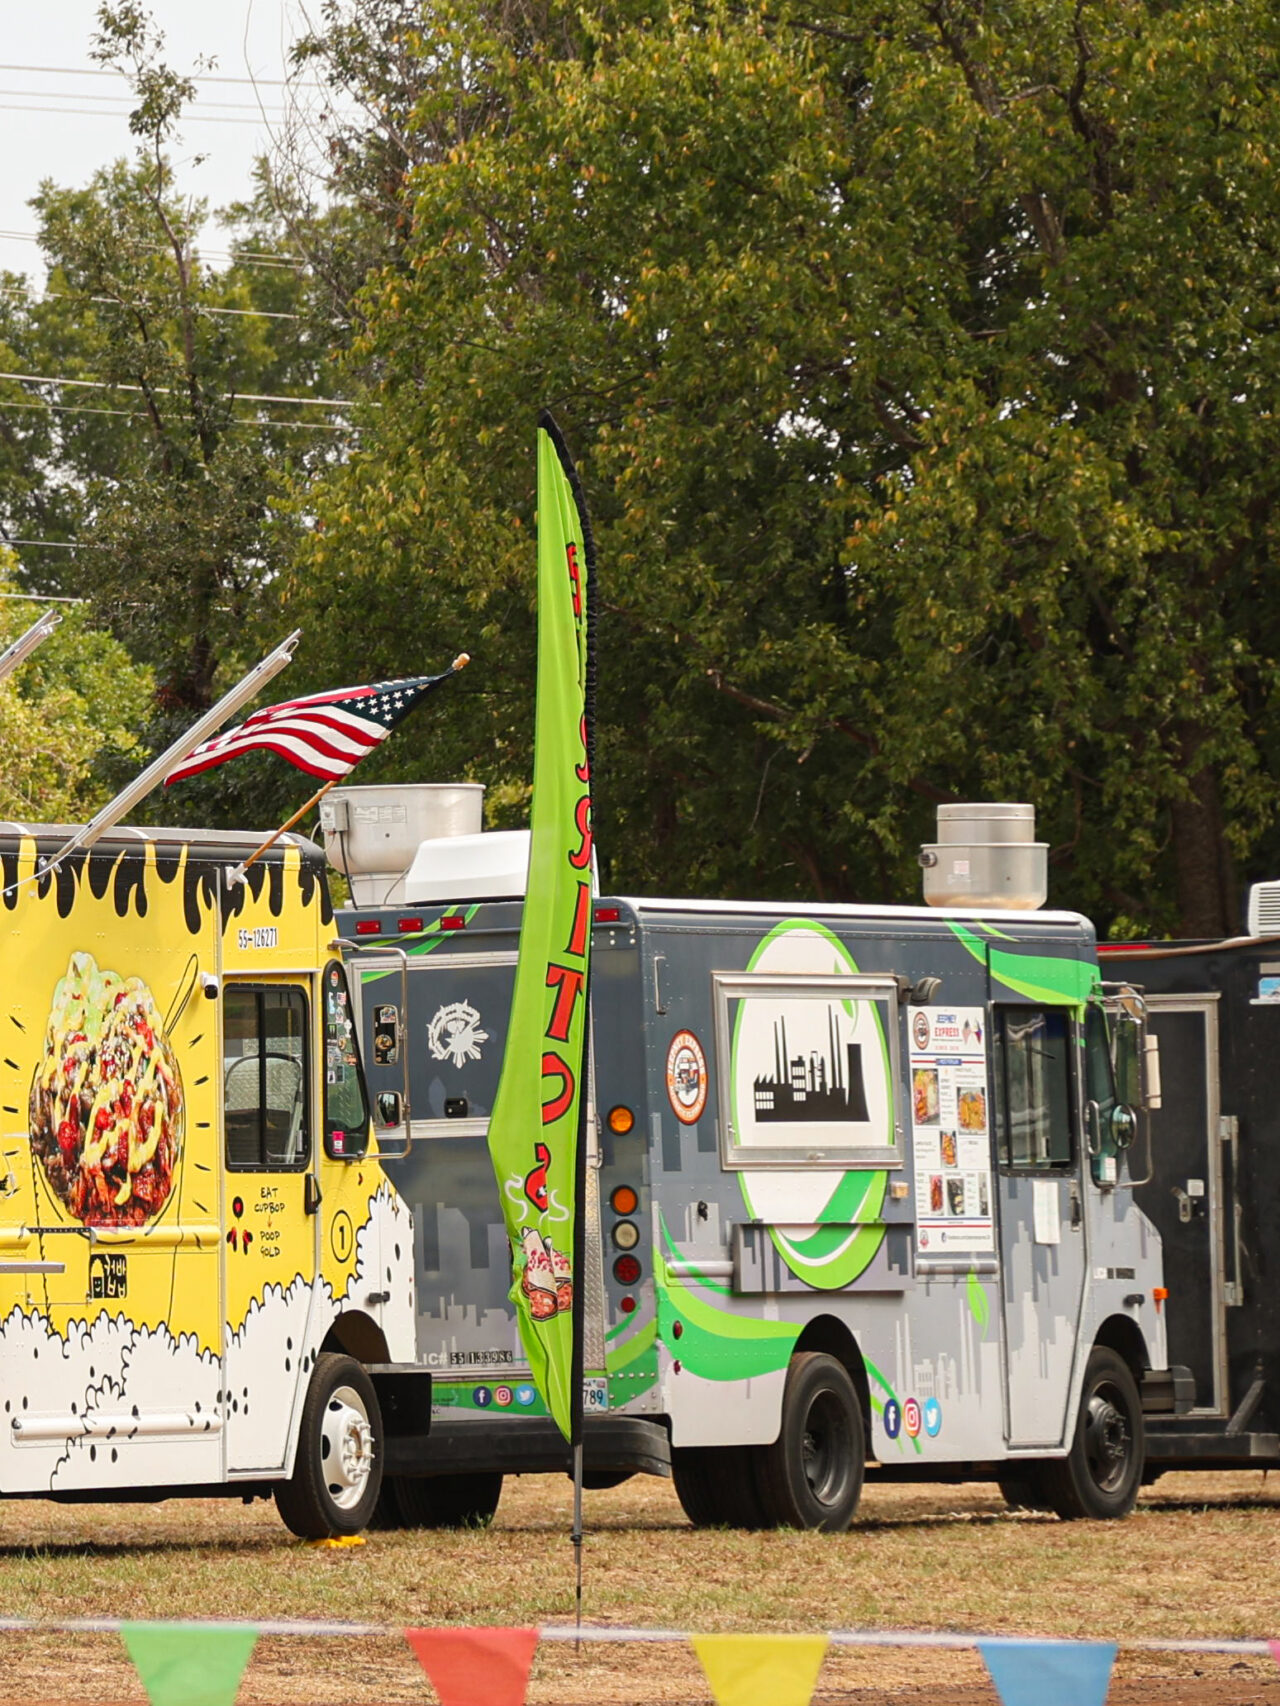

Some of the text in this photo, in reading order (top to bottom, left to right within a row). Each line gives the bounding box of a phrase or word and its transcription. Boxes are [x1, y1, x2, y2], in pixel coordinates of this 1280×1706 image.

[260, 1187, 278, 1199] EAT
[254, 1202, 285, 1214] CUPBOP
[260, 1231, 281, 1241] POOP
[338, 1225, 345, 1250] 1
[260, 1245, 281, 1258] GOLD
[451, 1352, 465, 1365] 55
[470, 1351, 512, 1364] 133986
[583, 1389, 603, 1405] 789
